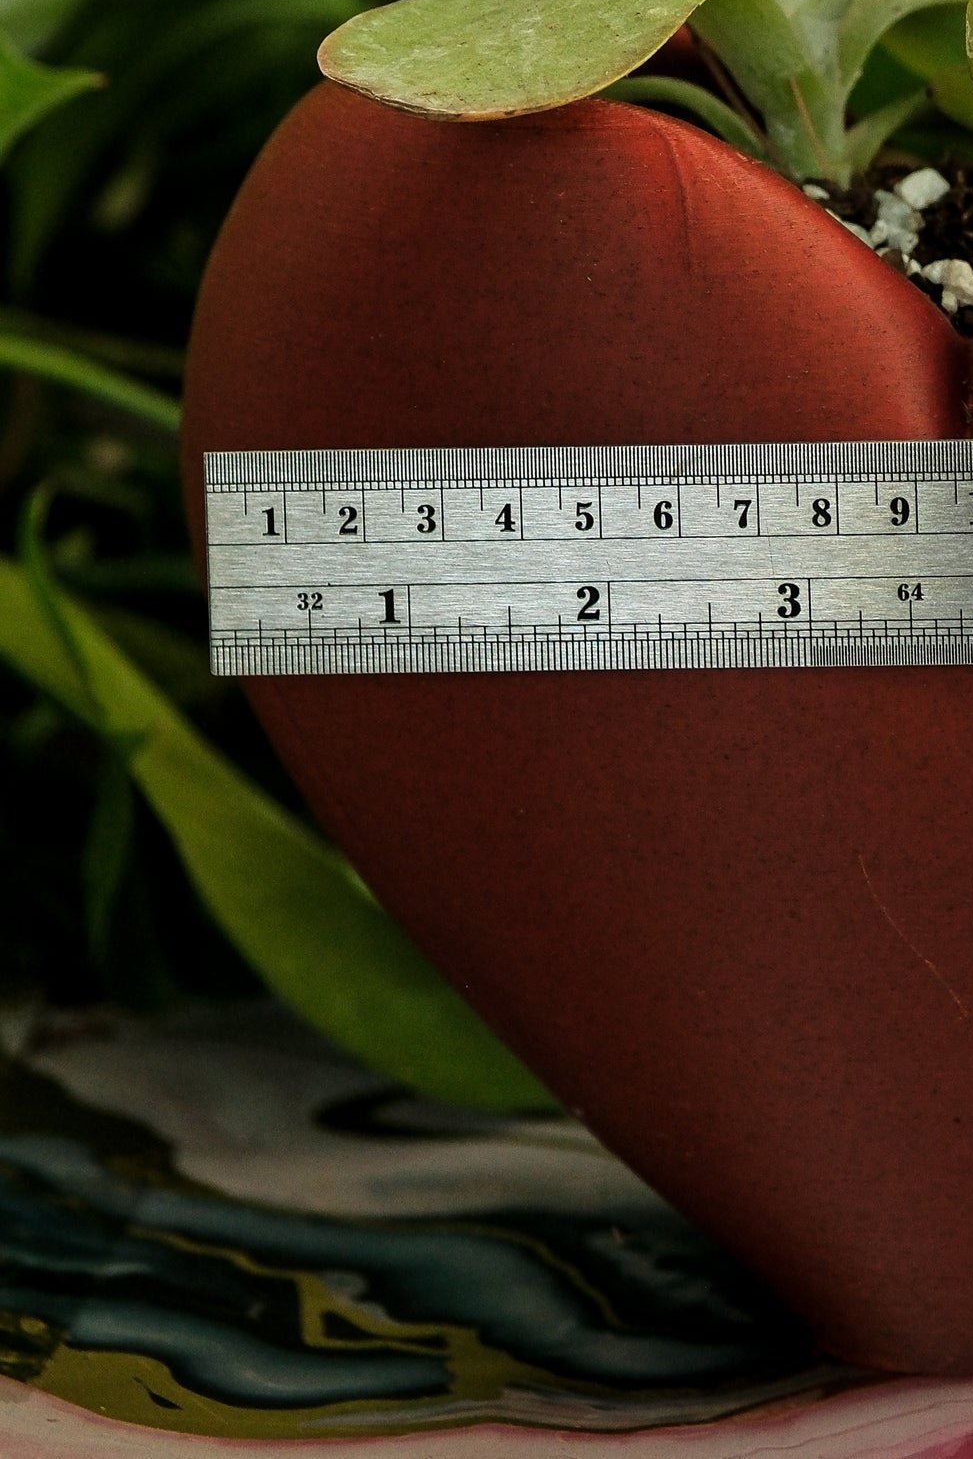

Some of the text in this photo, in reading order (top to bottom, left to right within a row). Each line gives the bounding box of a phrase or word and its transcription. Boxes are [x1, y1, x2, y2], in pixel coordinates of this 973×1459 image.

[261, 507, 280, 536] 1
[338, 506, 359, 536] 2
[416, 504, 437, 534] 3
[494, 503, 516, 533] 4
[574, 501, 595, 532] 5
[653, 500, 674, 530] 6
[732, 498, 752, 529] 7
[811, 498, 832, 528] 8
[889, 496, 910, 527] 9
[296, 591, 324, 611] 32
[378, 588, 401, 625] 1
[575, 585, 601, 622] 2
[777, 582, 801, 619] 3
[897, 582, 925, 601] 64
